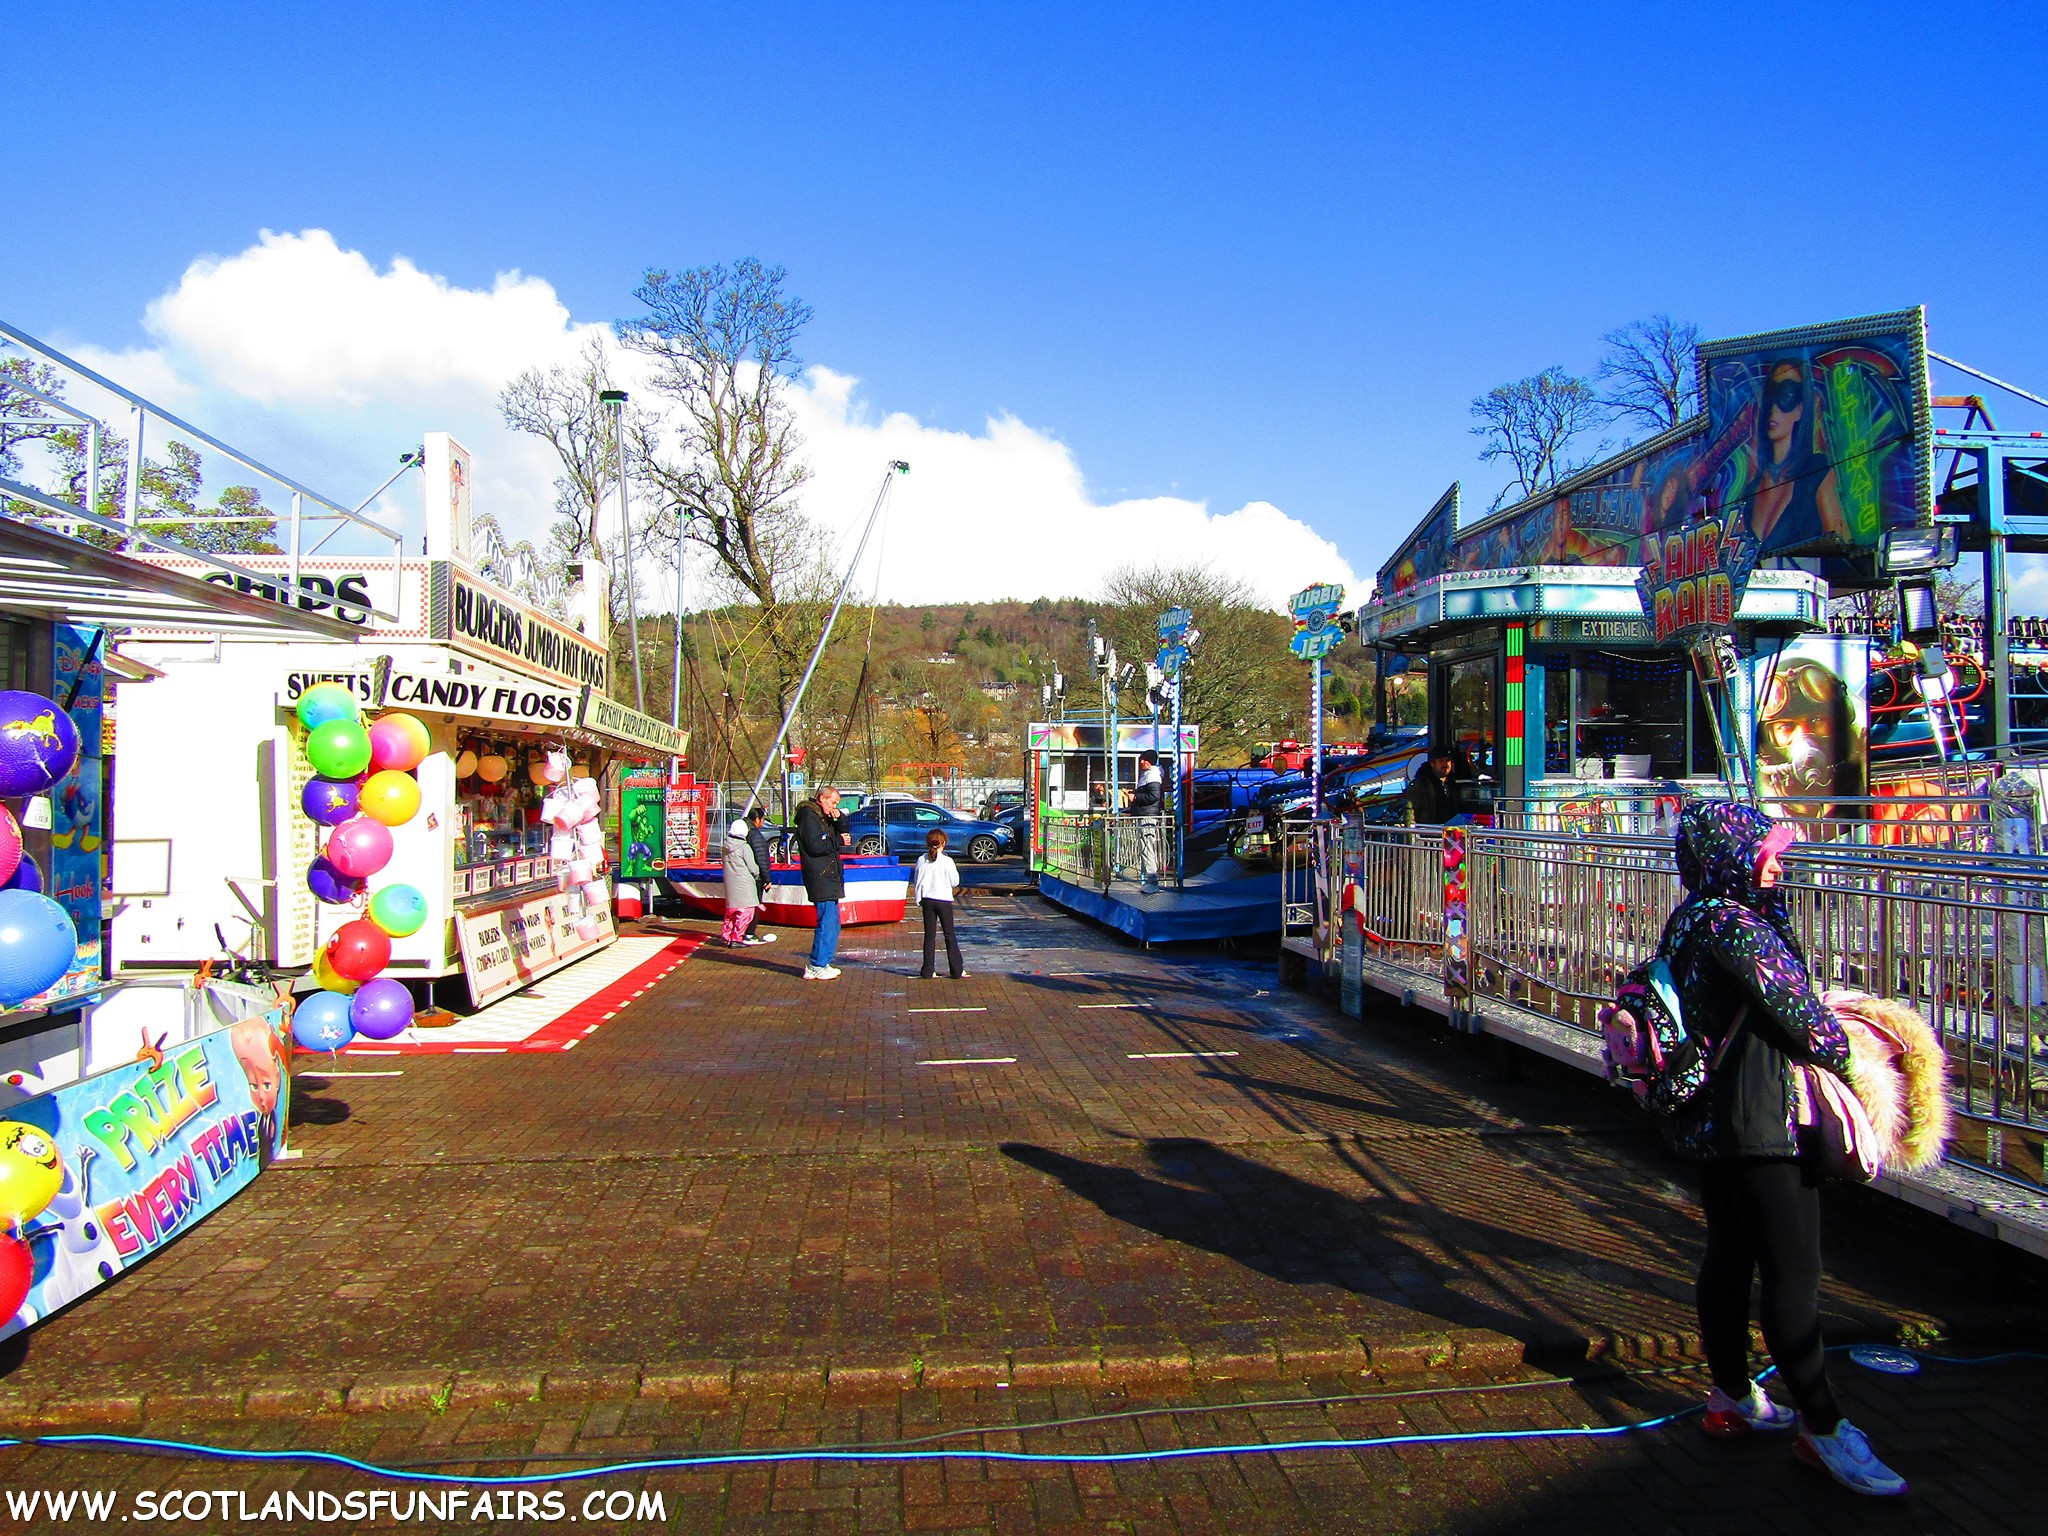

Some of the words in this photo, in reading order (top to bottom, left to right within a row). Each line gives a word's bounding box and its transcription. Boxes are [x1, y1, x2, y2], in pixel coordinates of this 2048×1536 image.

[1570, 488, 1643, 529] EXPLOSION
[1664, 521, 1719, 584] AIR
[1290, 584, 1343, 610] TURBO
[1655, 573, 1731, 642] RAID
[1159, 608, 1192, 628] TURBO
[1581, 621, 1638, 637] EXTREME
[455, 582, 522, 655] BURGERS
[525, 619, 560, 671] JUMBO
[562, 637, 580, 679] HOT
[581, 647, 604, 689] DOGS
[1299, 633, 1334, 660] JET
[1161, 652, 1183, 674] JET
[57, 692, 99, 708] DCKS
[288, 673, 370, 701] SWTS
[392, 675, 487, 710] CANDY
[492, 688, 572, 721] FLOSS
[1247, 821, 1261, 829] EXIT
[77, 935, 98, 959] uck
[478, 926, 501, 947] BURGERS
[82, 1044, 217, 1172] PRIZE
[94, 1154, 200, 1259] EVERY
[191, 1110, 259, 1184] TIME
